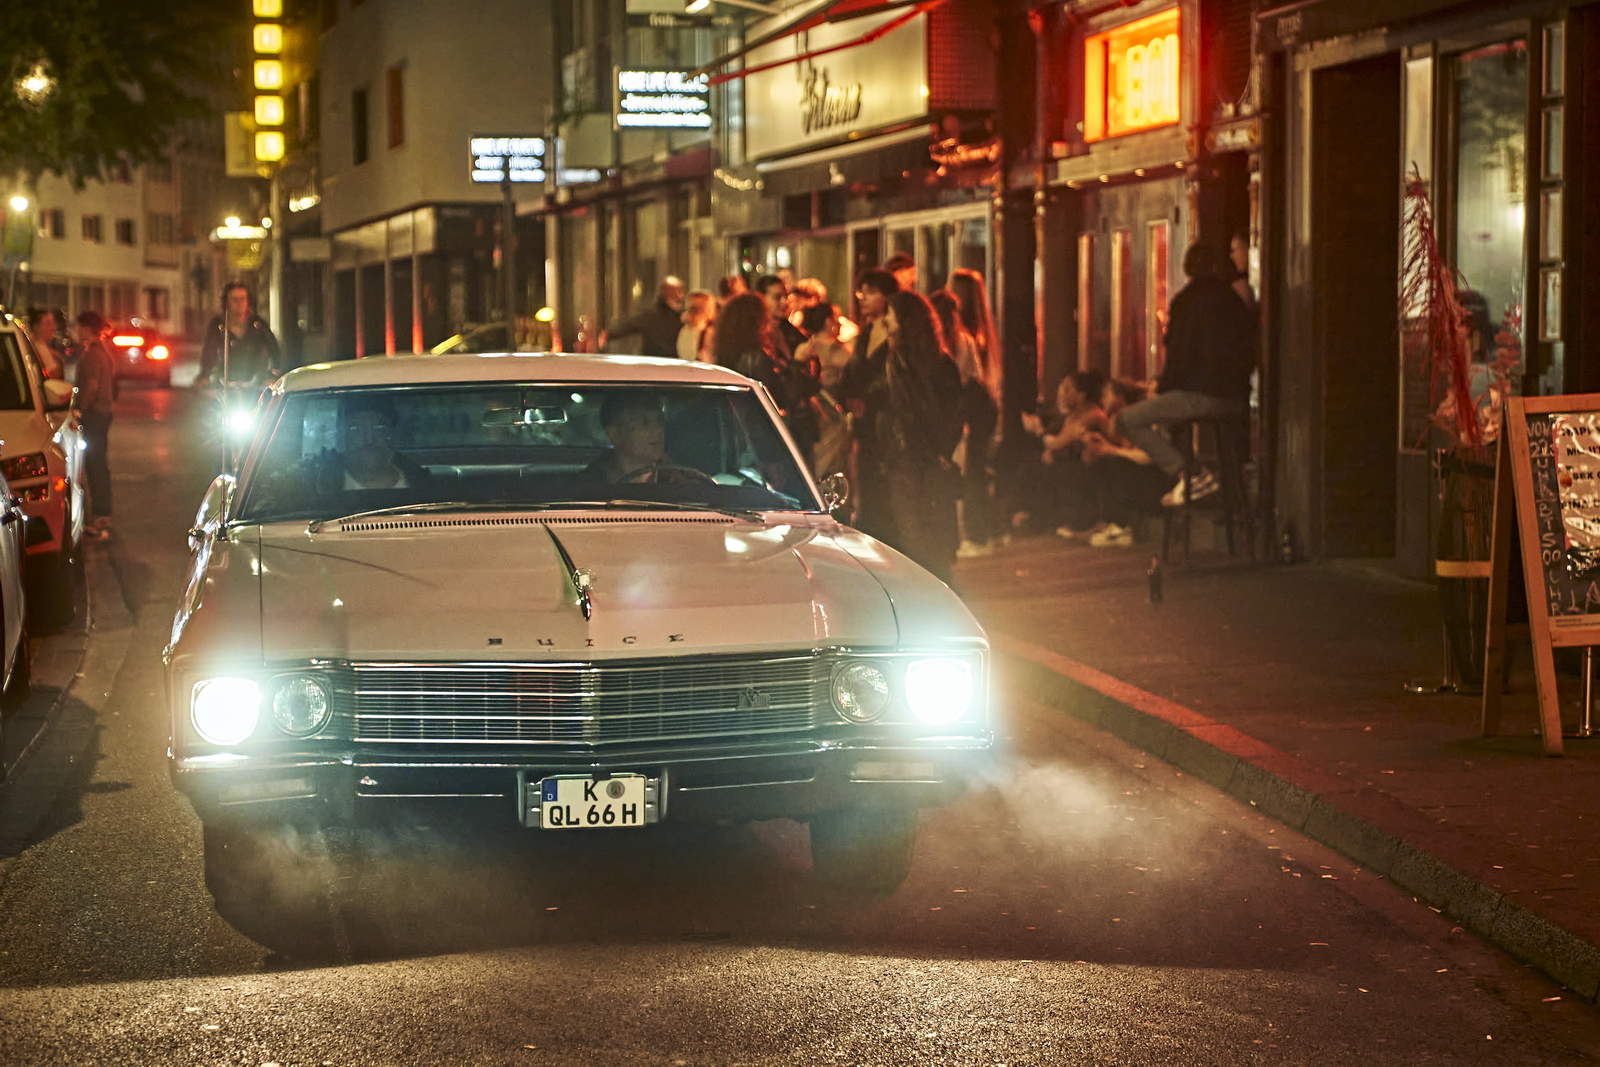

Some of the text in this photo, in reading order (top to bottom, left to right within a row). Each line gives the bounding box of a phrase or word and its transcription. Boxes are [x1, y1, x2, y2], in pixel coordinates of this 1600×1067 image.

[488, 633, 684, 647] BUICK
[584, 780, 598, 801] K
[549, 802, 637, 826] QL 66 H
